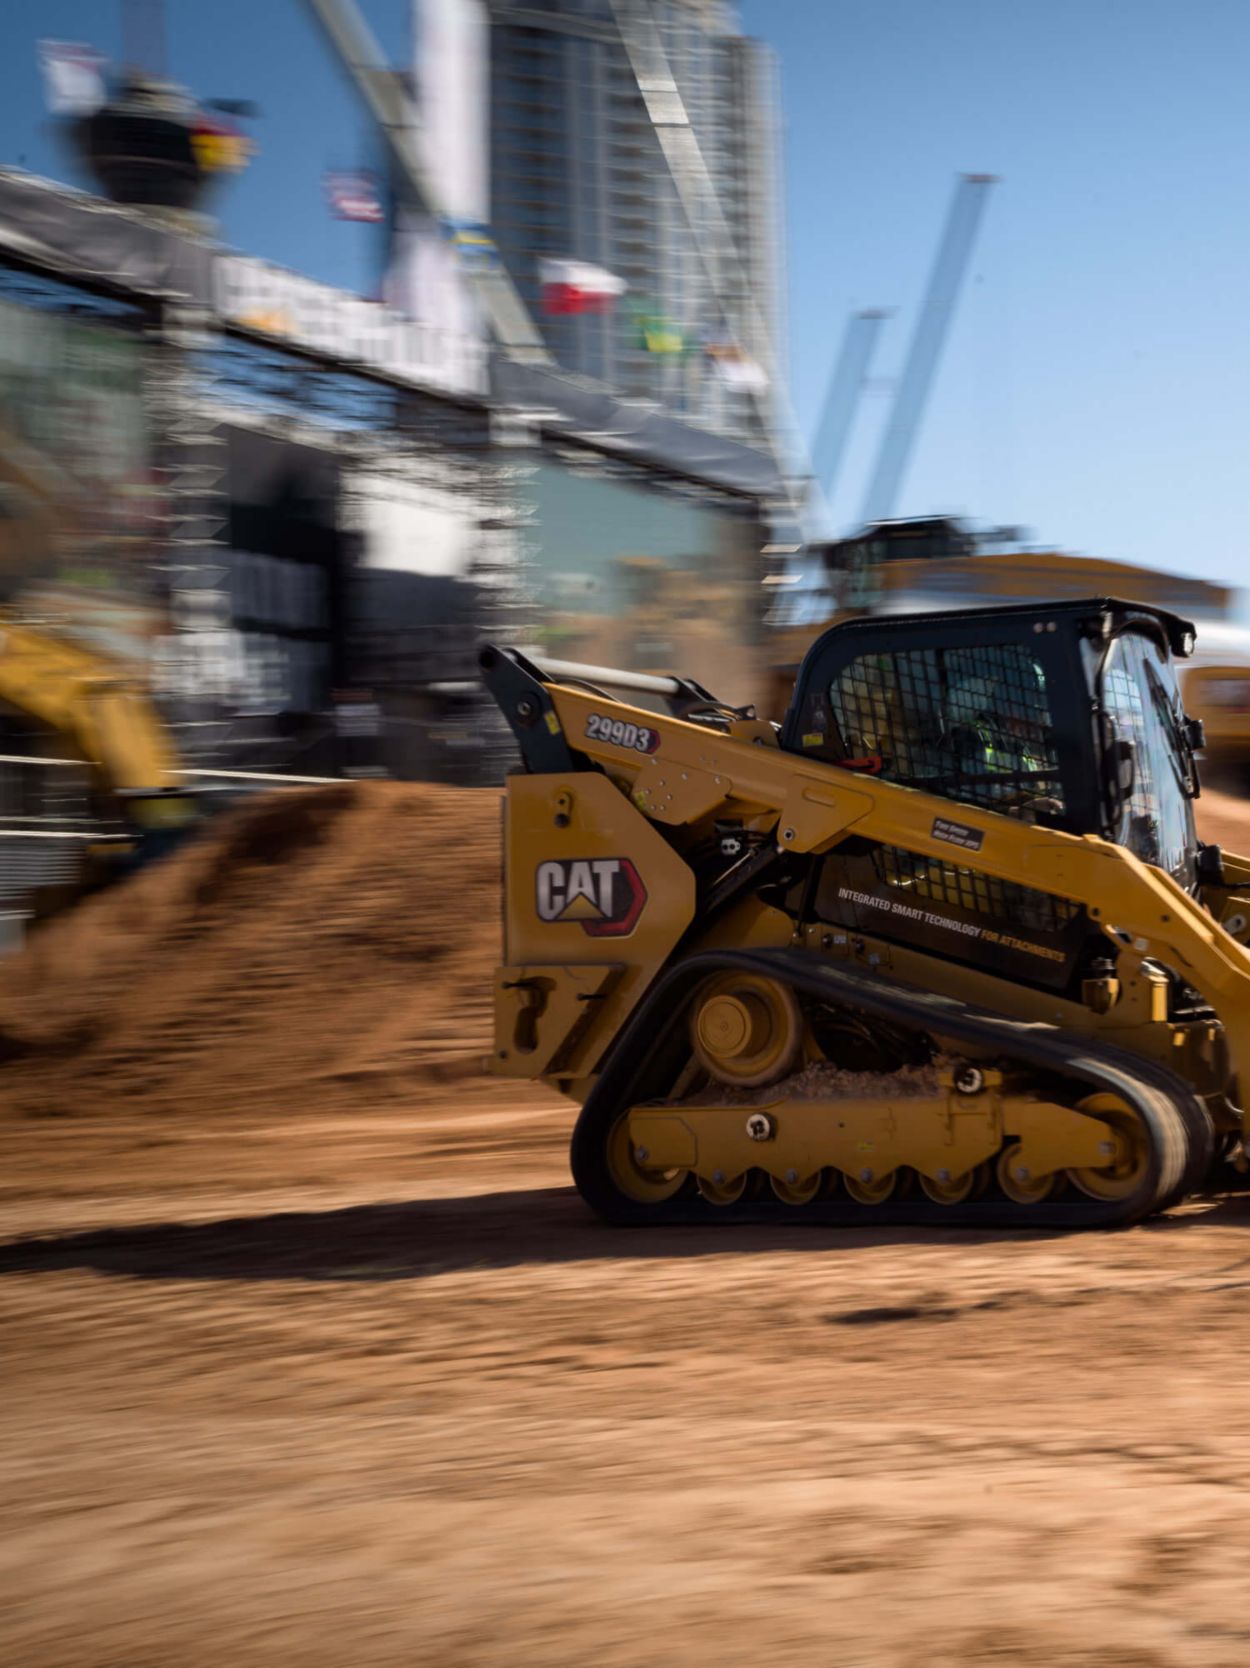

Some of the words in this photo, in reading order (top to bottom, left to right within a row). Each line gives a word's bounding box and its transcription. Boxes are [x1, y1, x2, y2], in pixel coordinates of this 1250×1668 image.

[585, 713, 650, 752] 299D3
[537, 860, 620, 921] CAT
[838, 887, 891, 911] INTEGRATED
[891, 903, 924, 920] SMART
[924, 913, 981, 938] TECHNOLOGY
[980, 929, 1000, 943] FOR
[999, 935, 1067, 962] ATTACHMENTS
